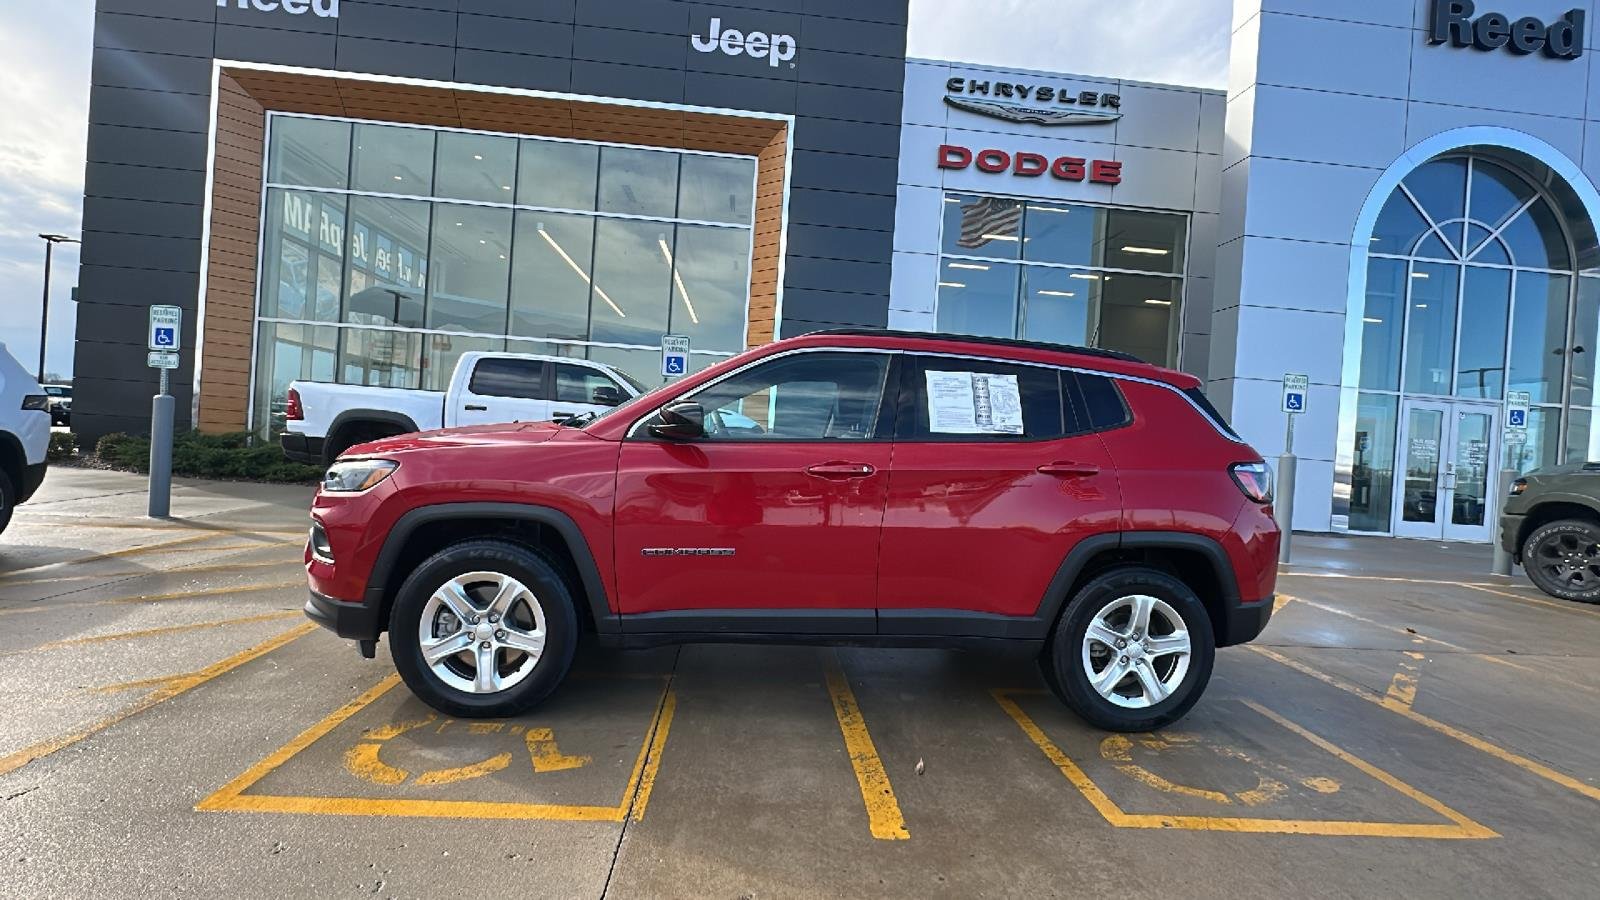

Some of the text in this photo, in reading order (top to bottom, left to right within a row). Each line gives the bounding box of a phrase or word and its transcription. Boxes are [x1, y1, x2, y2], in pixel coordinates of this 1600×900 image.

[216, 0, 339, 18] eed
[691, 17, 796, 67] Jeep
[1428, 0, 1585, 61] Reed
[946, 77, 1121, 108] CHRYSLER
[937, 144, 1122, 185] DODGE
